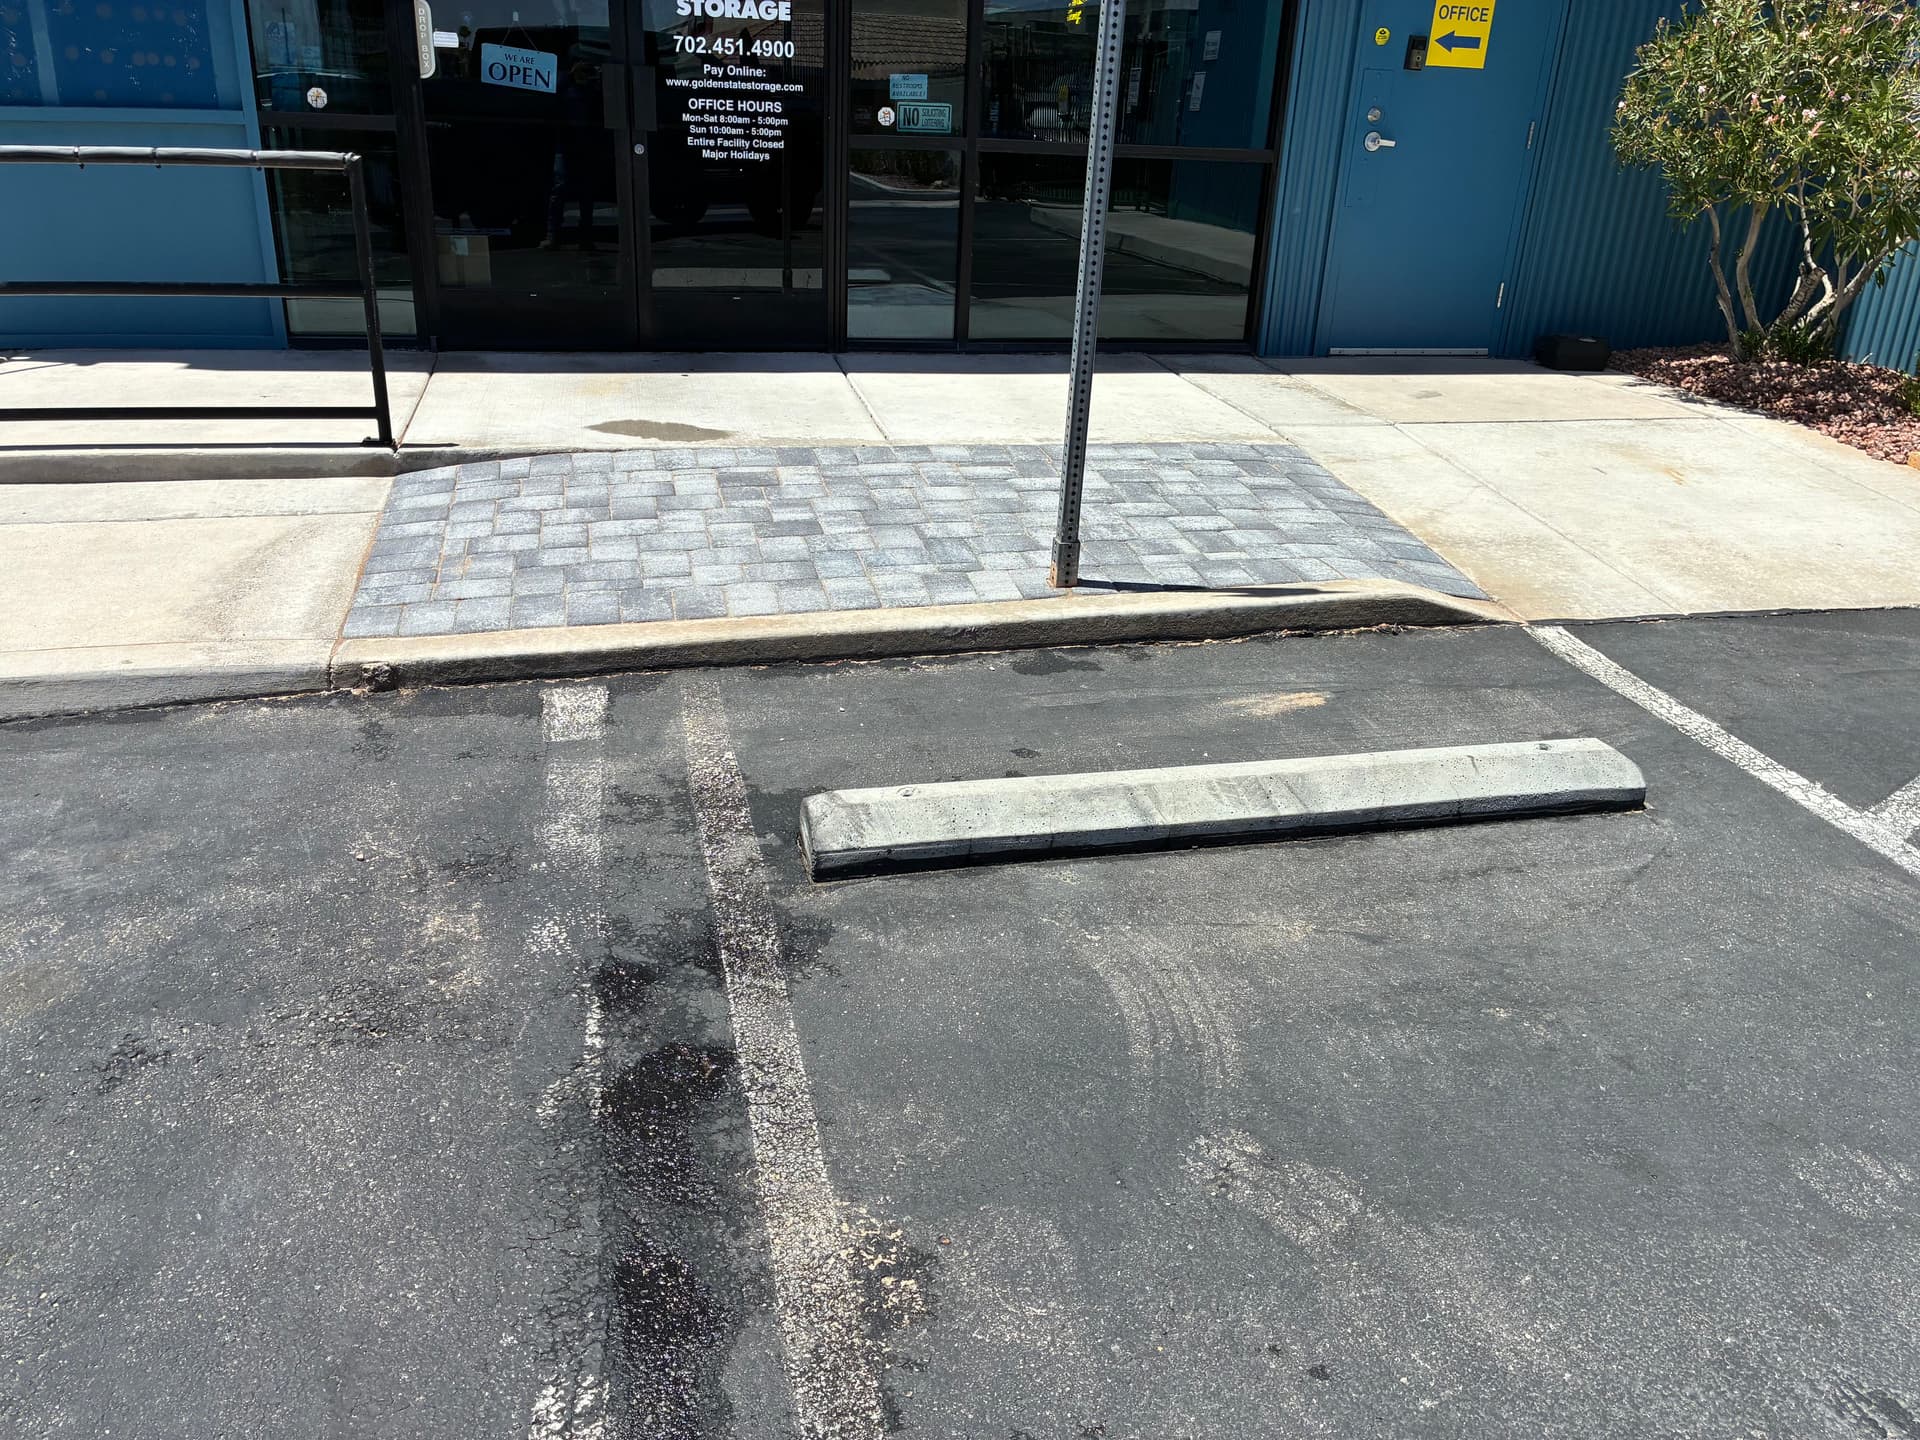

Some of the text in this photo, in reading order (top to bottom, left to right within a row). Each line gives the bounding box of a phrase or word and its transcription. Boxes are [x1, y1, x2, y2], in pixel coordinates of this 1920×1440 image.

[676, 0, 791, 21] STORAGE
[1438, 4, 1490, 22] OFFICE
[418, 7, 430, 68] DROP BOX
[673, 35, 795, 58] 702.451.4900
[504, 53, 535, 65] WE ARE
[488, 62, 551, 88] OPEN
[703, 64, 767, 77] Pay Online:
[665, 78, 804, 92] www.goldenstatestorage.com
[688, 98, 782, 113] OFFICE HOURS
[682, 113, 718, 123] Mon-Sat
[719, 115, 750, 125] 8:00am
[757, 116, 789, 127] 5:00pm
[903, 107, 920, 127] NO
[689, 125, 707, 134] Sun
[709, 126, 744, 135] 10:00am
[751, 128, 782, 138] 5:00pm
[687, 137, 785, 149] Entire Facility Closed
[702, 150, 770, 162] Major Holidays
